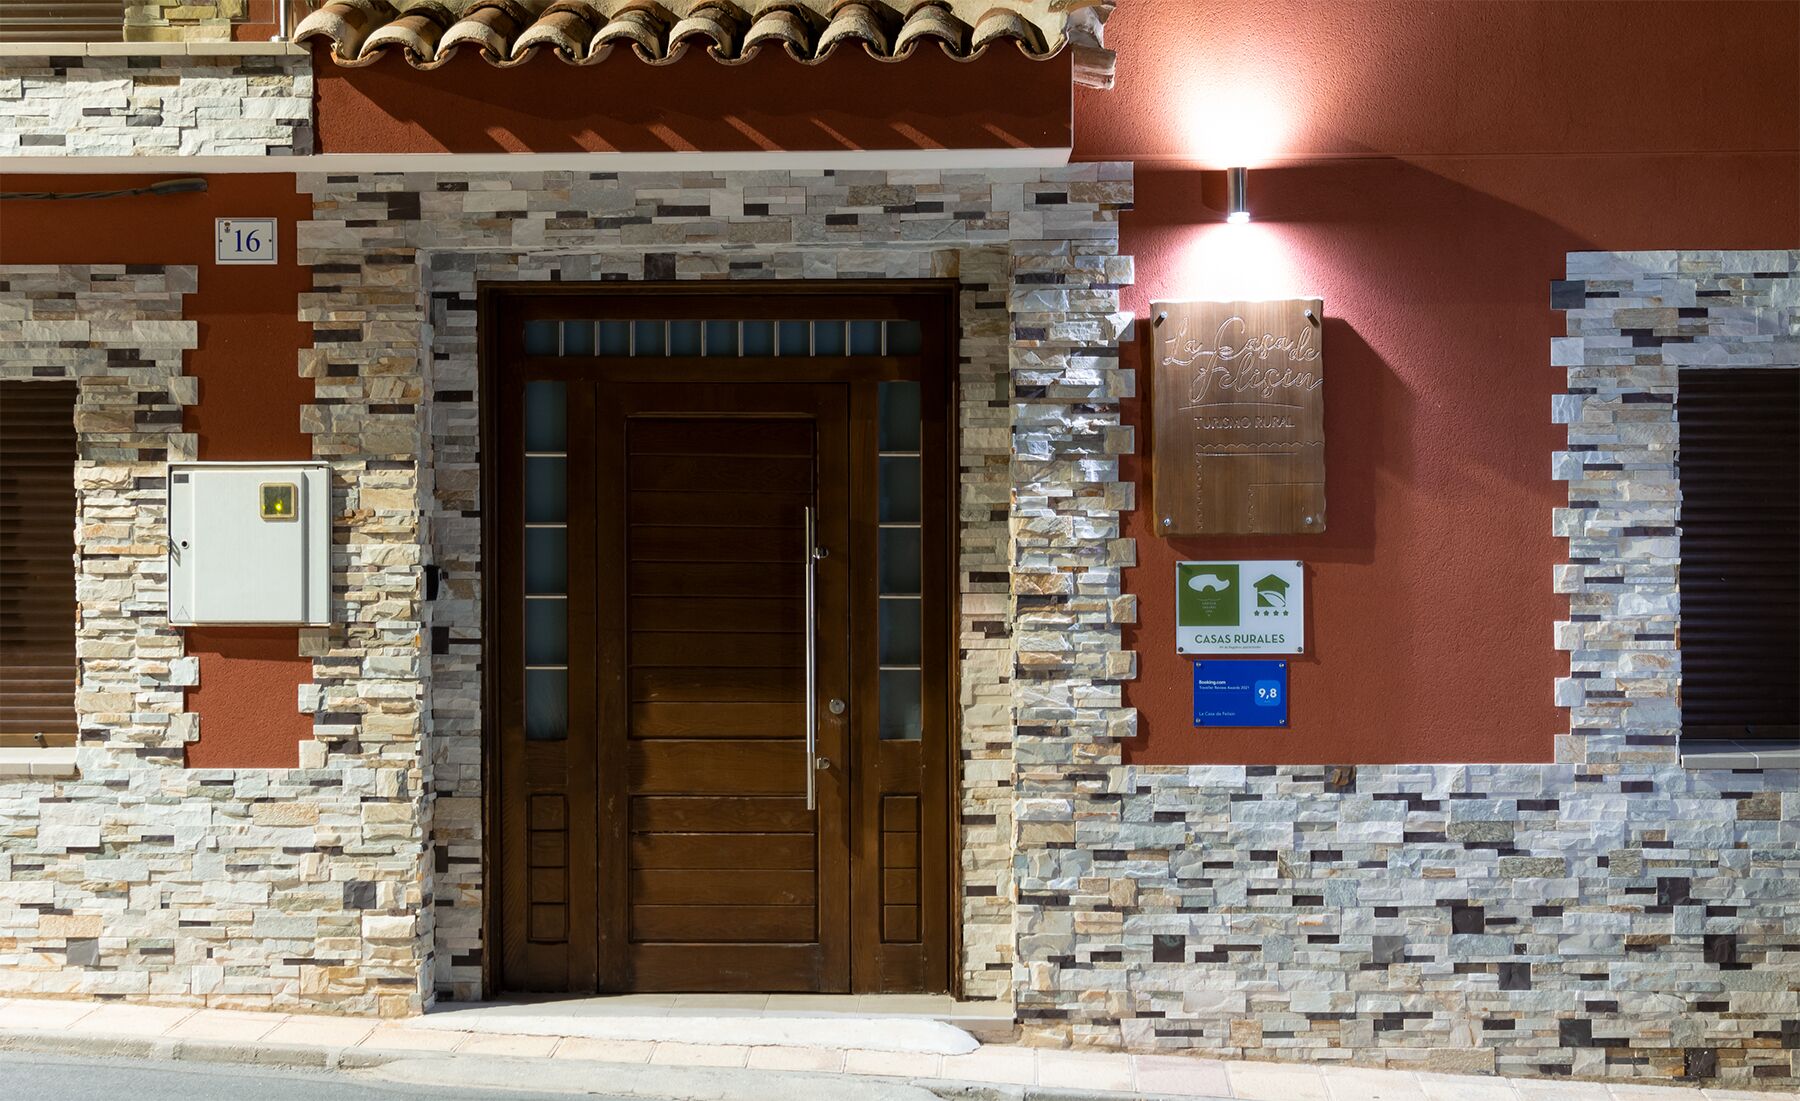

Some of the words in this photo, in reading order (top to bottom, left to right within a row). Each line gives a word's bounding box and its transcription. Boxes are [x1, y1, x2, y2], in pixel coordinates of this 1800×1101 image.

[235, 229, 261, 252] 16
[1162, 315, 1203, 366] La
[1213, 316, 1294, 360] Casa
[1288, 325, 1321, 362] de
[1193, 416, 1252, 430] TURISMO
[1254, 415, 1296, 429] RURAL
[1194, 634, 1231, 644] CASAS
[1234, 634, 1285, 644] RURALES
[1258, 688, 1278, 699] 9,8
